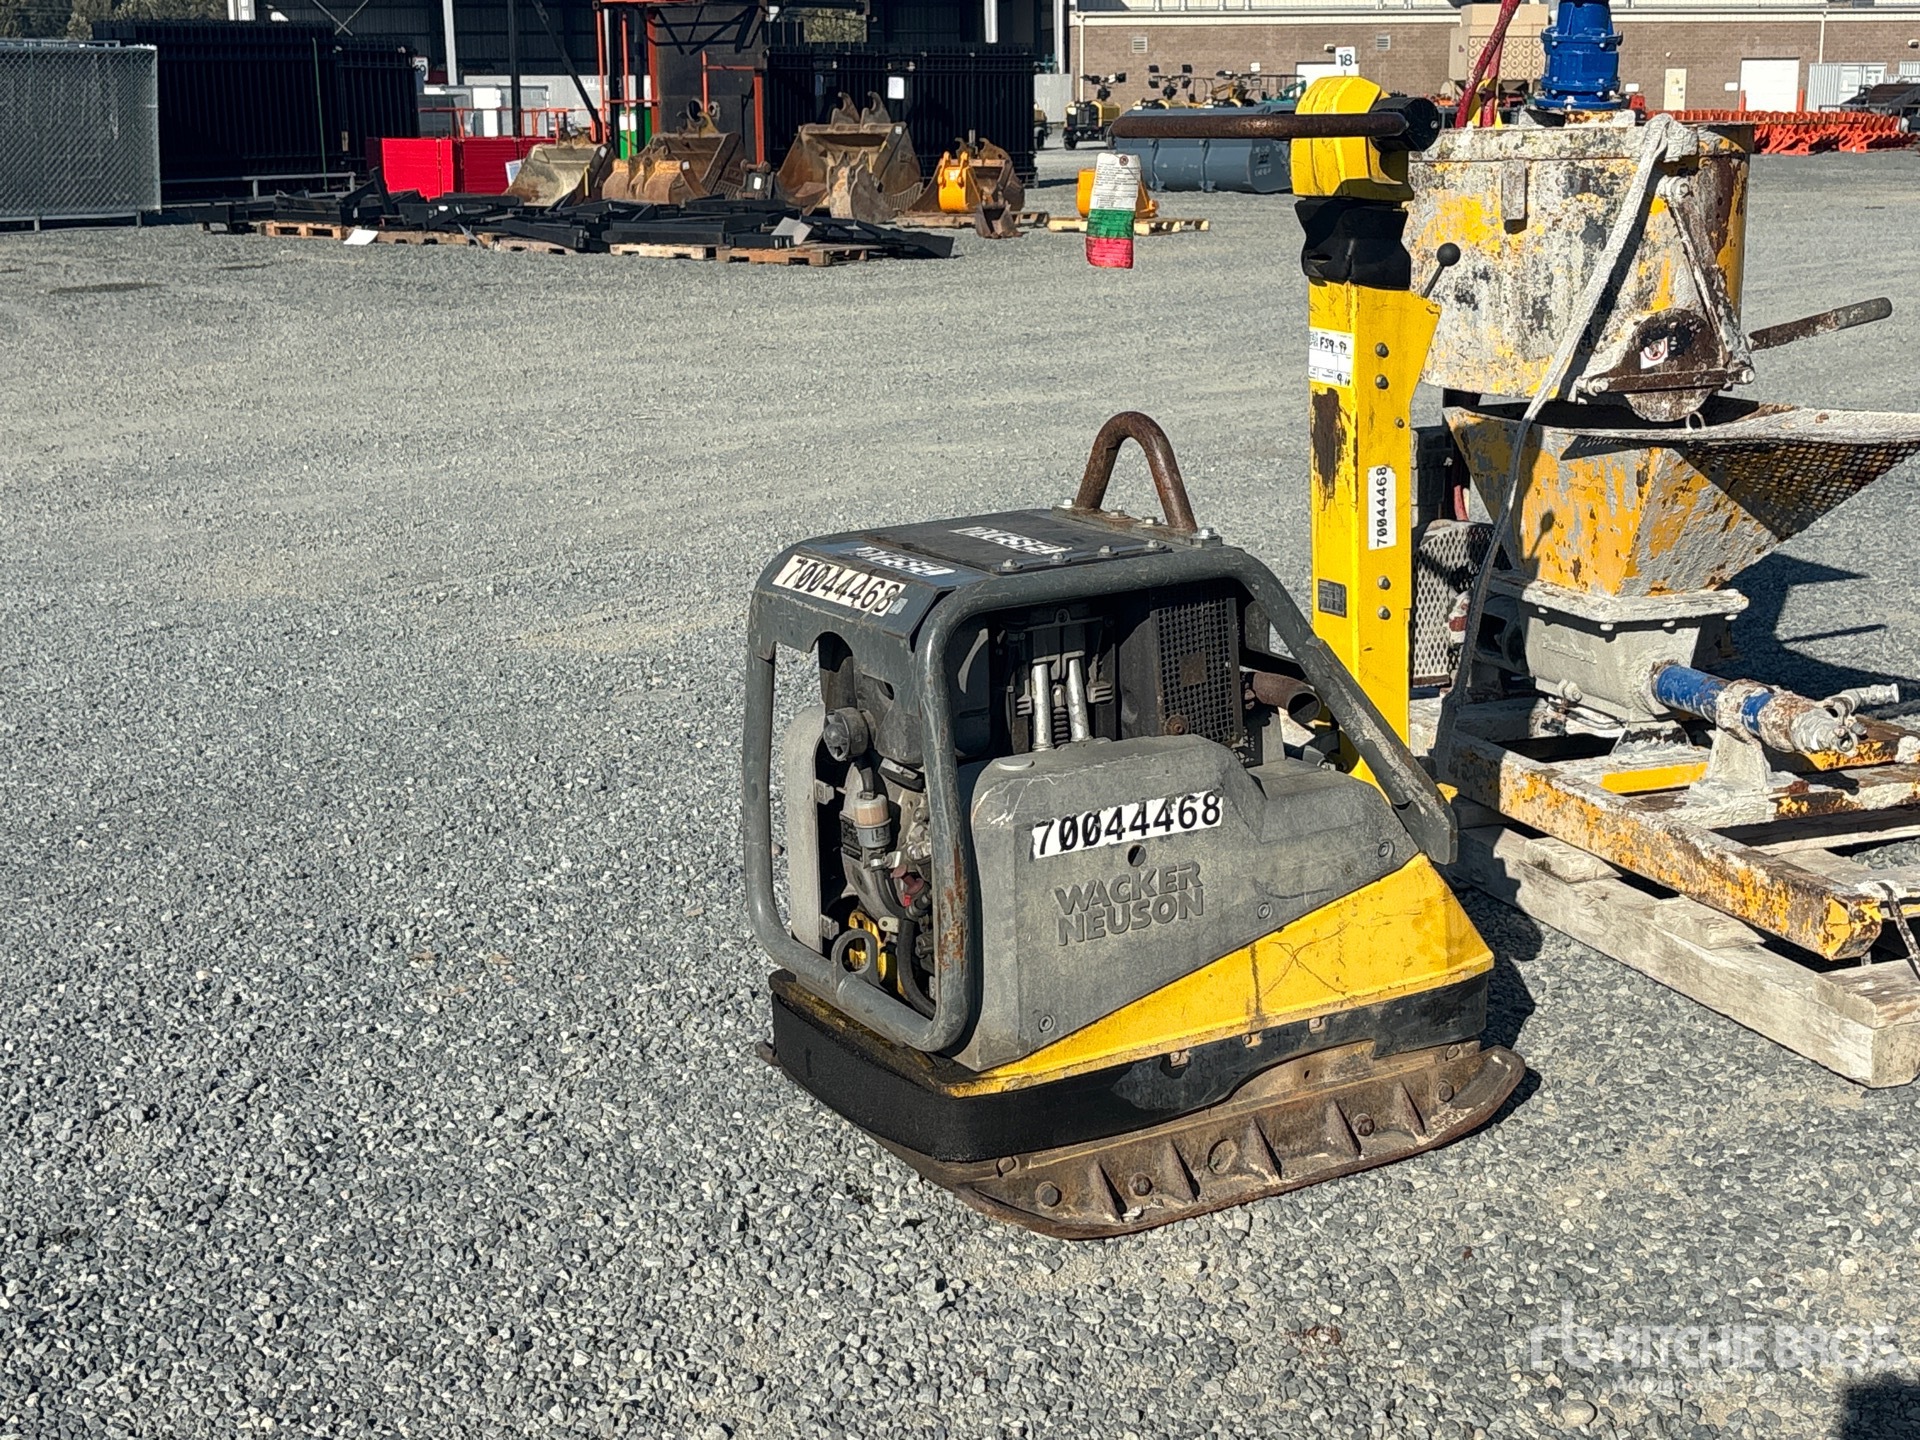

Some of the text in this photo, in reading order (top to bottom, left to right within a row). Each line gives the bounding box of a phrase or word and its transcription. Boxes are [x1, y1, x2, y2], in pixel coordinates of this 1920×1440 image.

[1338, 53, 1353, 67] 18
[1375, 466, 1388, 547] 70044468
[781, 557, 903, 615] 70044468
[1034, 793, 1221, 856] 70044468
[1053, 860, 1204, 916] WACKER
[1057, 888, 1204, 946] NEUSON
